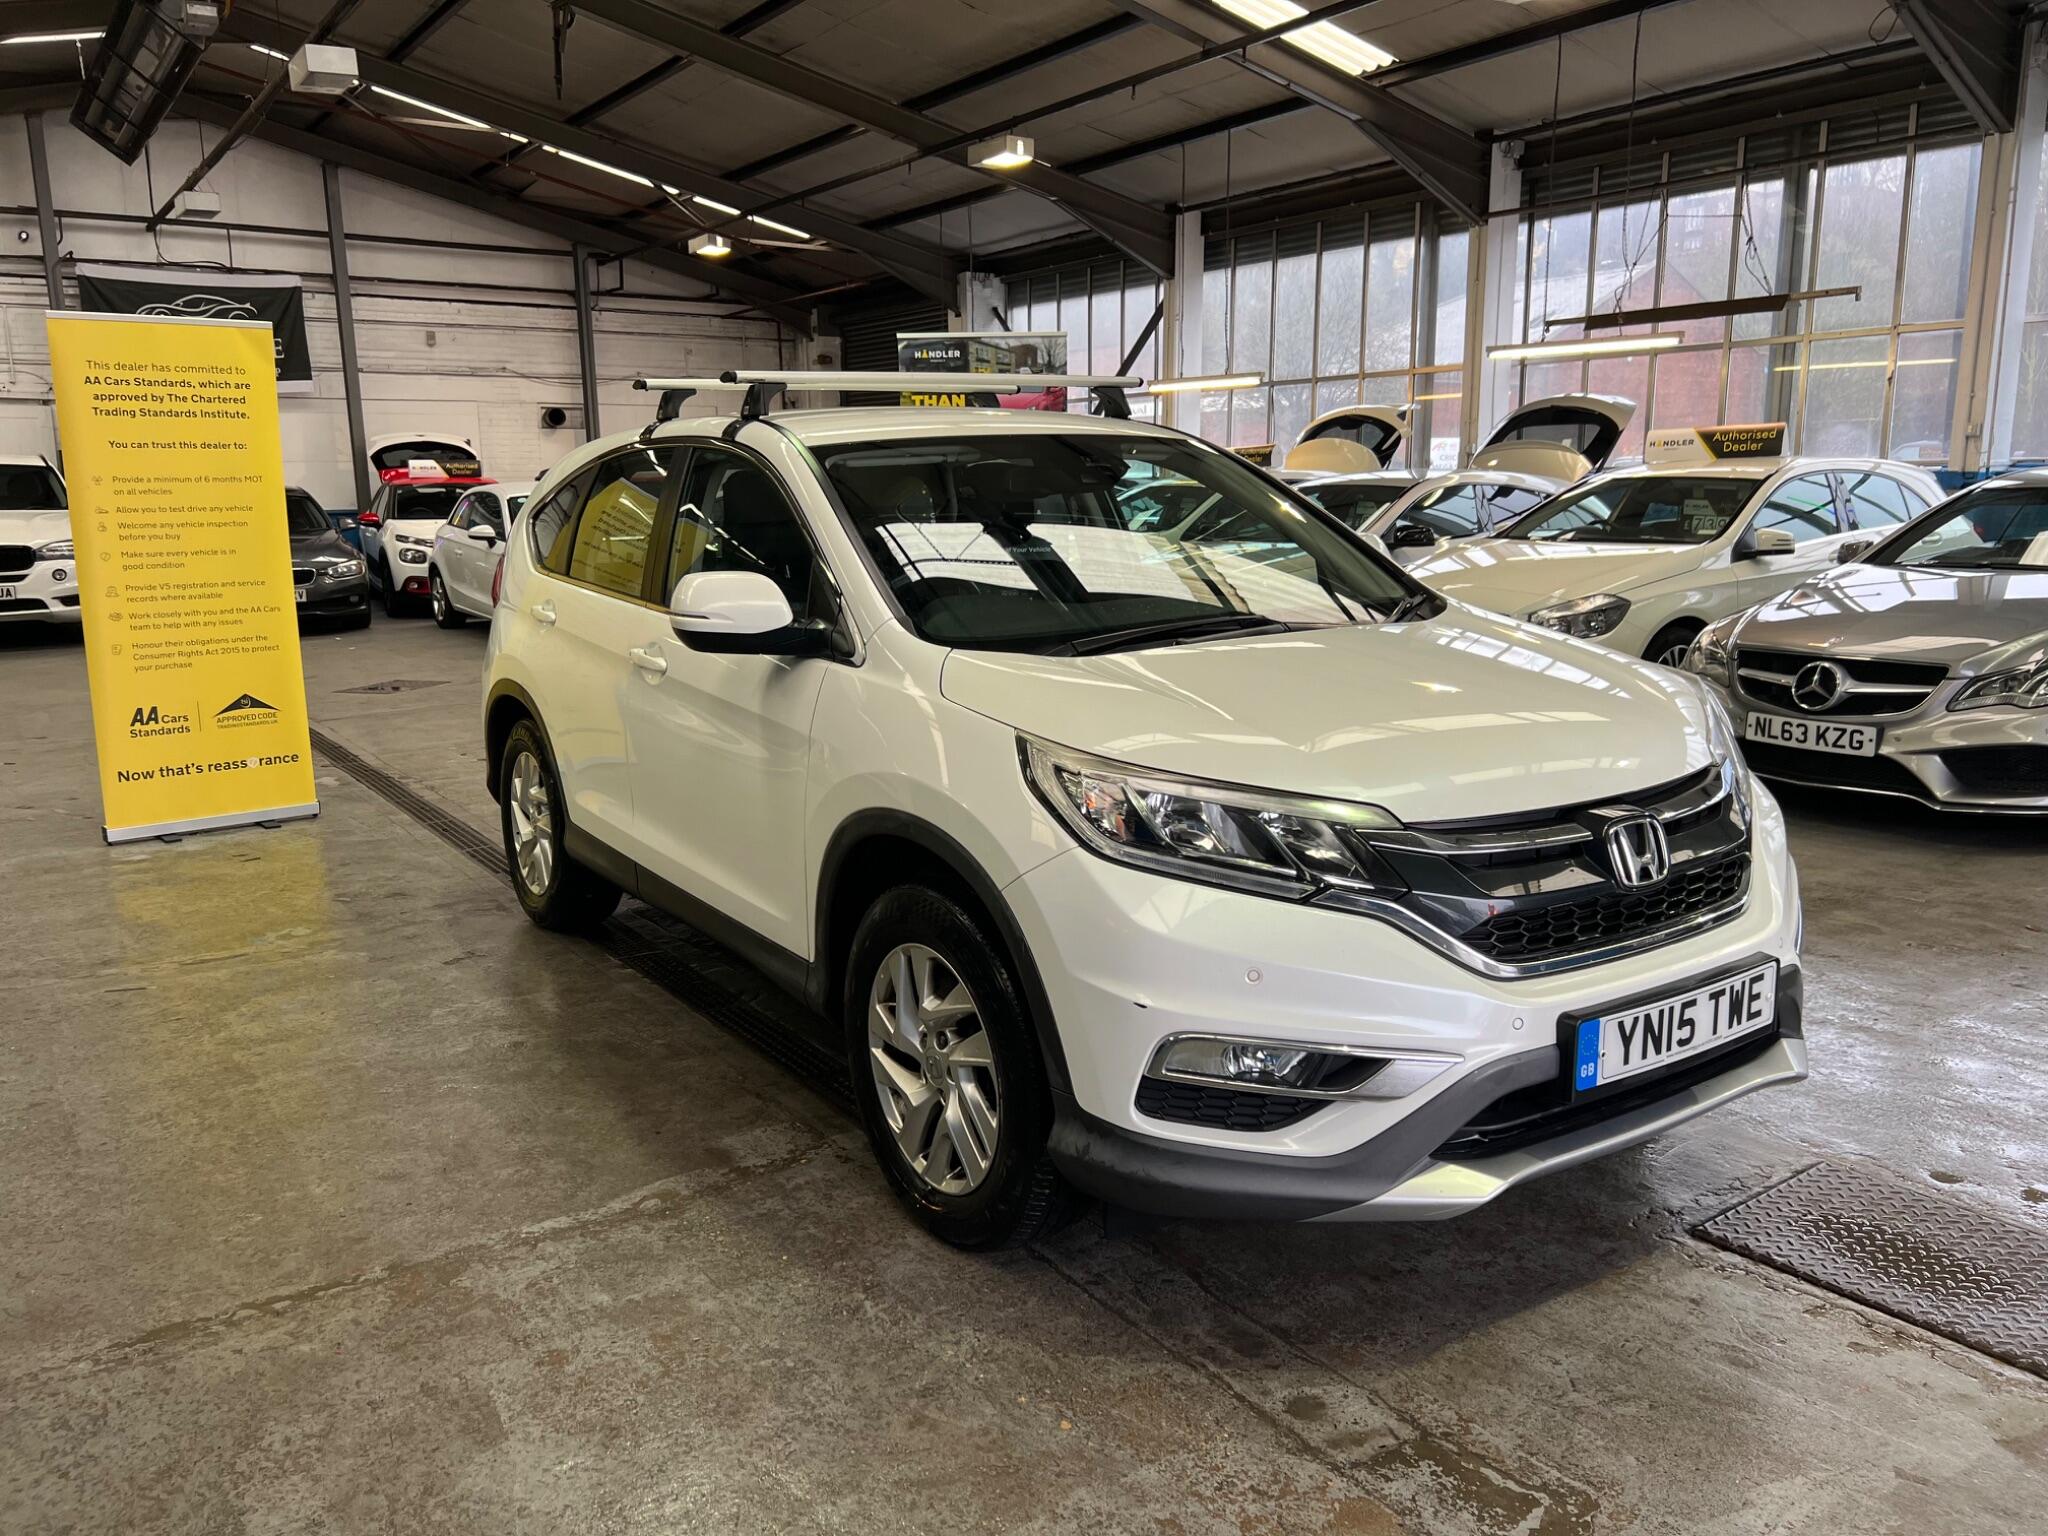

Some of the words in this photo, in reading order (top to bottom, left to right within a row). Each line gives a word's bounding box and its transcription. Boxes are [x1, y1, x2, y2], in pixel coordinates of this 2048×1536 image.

[86, 360, 110, 371] This
[114, 361, 148, 372] dealer
[152, 363, 171, 373] has
[175, 364, 232, 375] committed
[236, 367, 246, 375] to
[84, 376, 101, 385] AA
[104, 377, 131, 386] Cars
[134, 378, 196, 389] Standards,
[198, 380, 231, 389] which
[234, 382, 251, 390] are
[93, 393, 148, 402] approved
[151, 393, 164, 404] by
[167, 394, 188, 403] The
[191, 395, 246, 404] Chartered
[92, 407, 136, 418] Trading
[140, 408, 197, 418] Standards
[200, 410, 250, 419] Institute.
[1713, 429, 1777, 442] Authorised
[109, 441, 128, 449] You
[152, 441, 176, 449] trust
[179, 441, 198, 450] this
[200, 441, 231, 450] dealer
[234, 442, 247, 450] to:
[1724, 441, 1764, 453] Dealer
[112, 476, 144, 484] Provide
[153, 476, 192, 484] minimum
[245, 475, 263, 483] MOT
[127, 488, 136, 496] all
[139, 488, 173, 496] vehicles
[116, 506, 139, 514] Allow
[142, 507, 156, 515] you
[117, 521, 157, 529] Welcome
[207, 520, 249, 529] inspection
[119, 533, 146, 541] before
[166, 533, 180, 541] buy
[121, 551, 144, 559] Make
[166, 551, 188, 559] every
[190, 549, 218, 557] vehicle
[229, 548, 236, 556] in
[122, 563, 144, 571] good
[146, 562, 185, 570] condition
[126, 584, 157, 592] Provide
[173, 581, 219, 591] registration
[126, 596, 158, 604] records
[188, 592, 223, 601] available
[129, 612, 151, 620] Work
[153, 611, 182, 620] closely
[184, 610, 201, 618] with
[264, 605, 281, 613] Cars
[163, 622, 182, 630] help
[184, 620, 201, 628] with
[203, 620, 216, 628] any
[132, 642, 163, 650] Honour
[165, 640, 184, 648] their
[186, 637, 229, 648] obligations
[256, 634, 268, 642] the
[133, 652, 176, 661] Consumer
[178, 650, 204, 659] Rights
[205, 648, 219, 656] Act
[220, 647, 240, 655] 2015
[252, 644, 280, 653] protect
[134, 665, 153, 673] your
[155, 662, 193, 671] purchase
[130, 706, 160, 727] AA
[162, 714, 189, 724] Cars
[217, 714, 257, 724] APPROVED
[258, 712, 278, 720] CODE
[130, 725, 191, 738] Standards
[1754, 716, 1808, 744] NL63
[1815, 725, 1864, 751] KZG
[118, 770, 155, 783] Now
[208, 753, 299, 773] reassrance
[1618, 998, 1698, 1067] YN15
[1708, 972, 1765, 1037] TWE
[1580, 1063, 1595, 1079] GB
